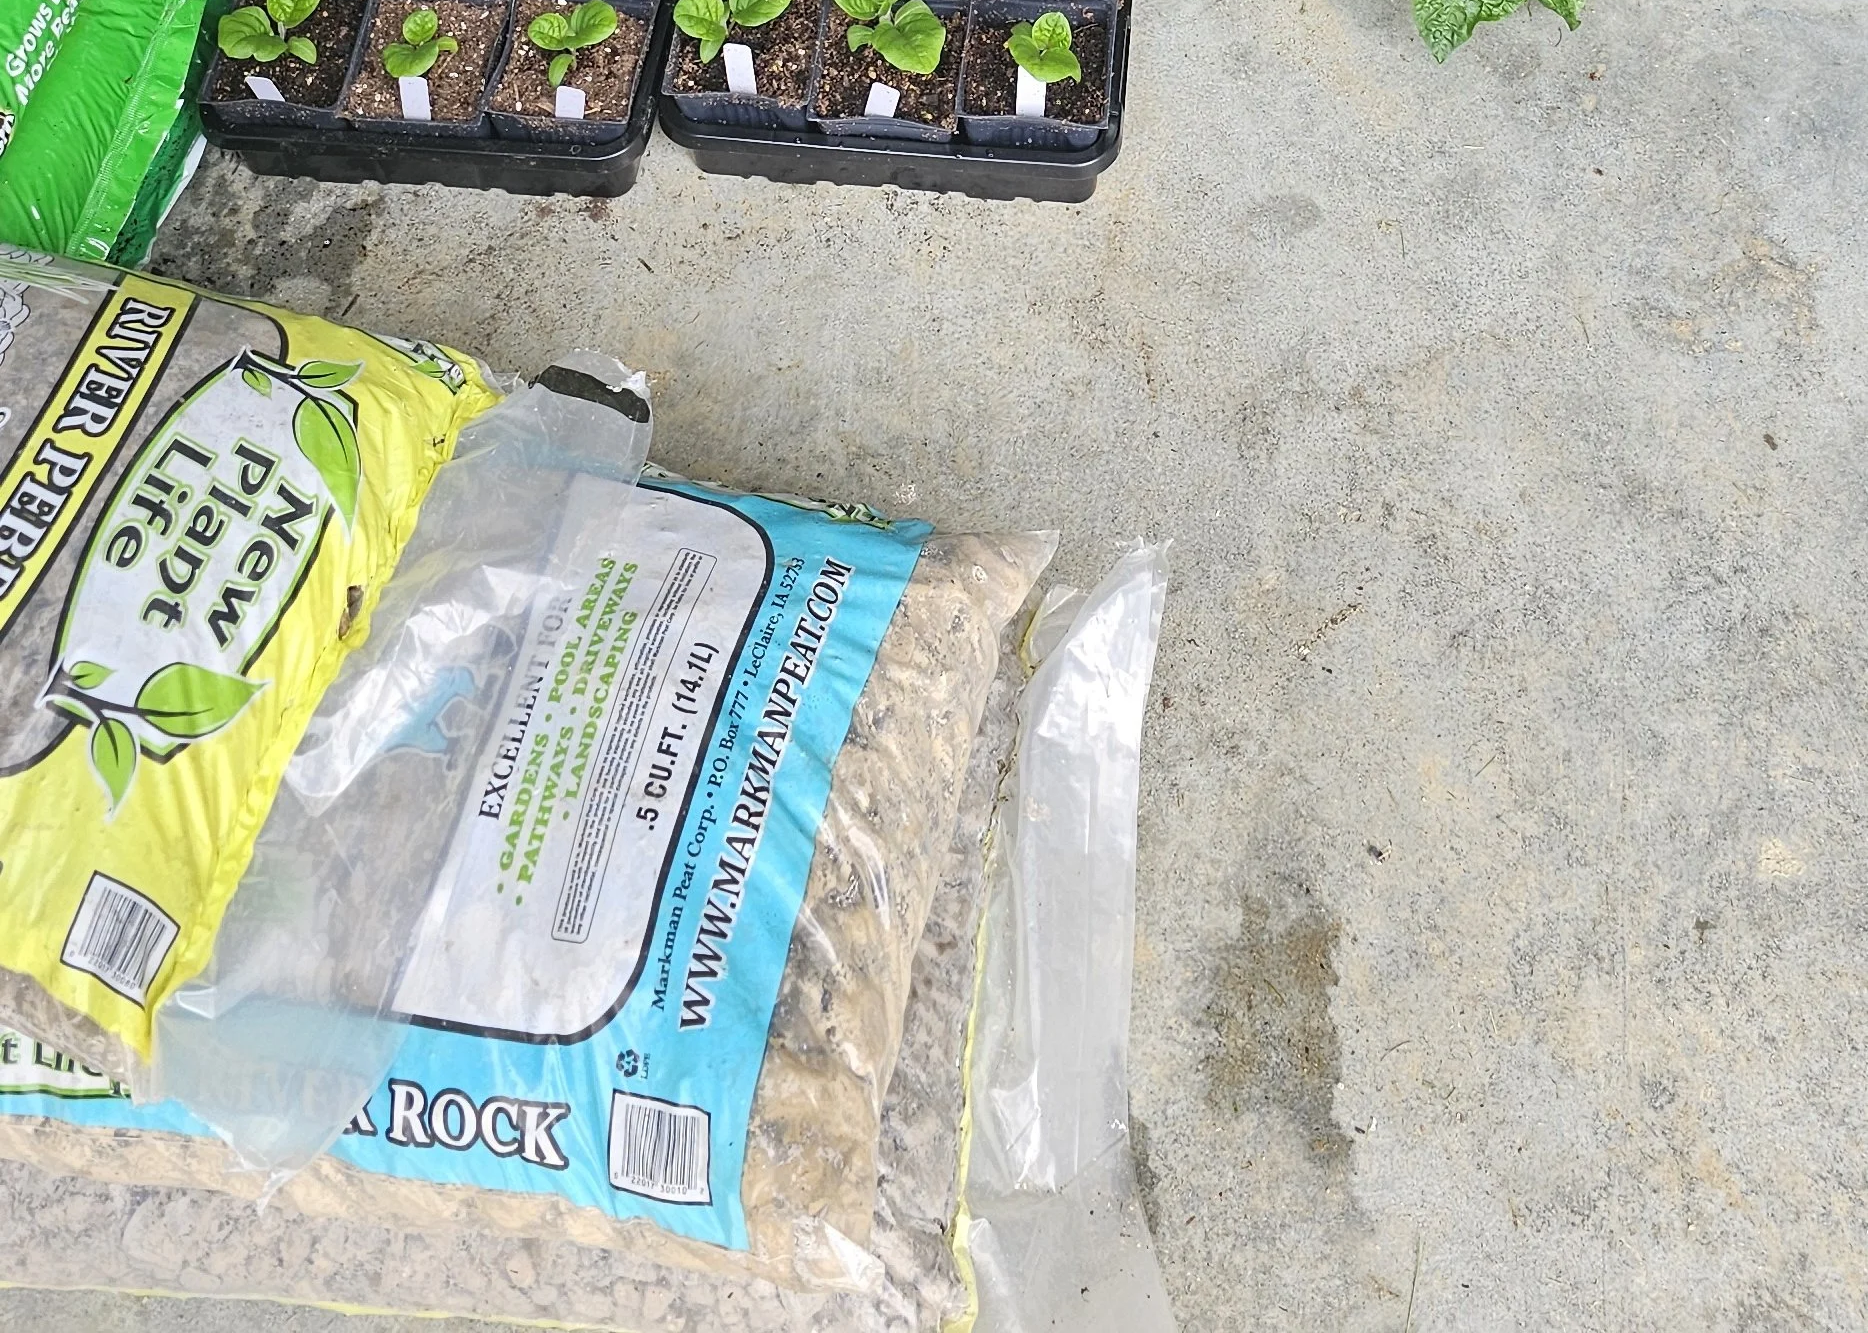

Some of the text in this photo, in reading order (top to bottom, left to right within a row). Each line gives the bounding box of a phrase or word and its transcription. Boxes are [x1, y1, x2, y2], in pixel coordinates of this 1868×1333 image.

[15, 37, 56, 106] More
[52, 297, 175, 437] RIVER
[106, 437, 213, 569] Life
[142, 441, 276, 629] Plant
[206, 480, 321, 650] New
[771, 591, 789, 610] IA
[744, 607, 784, 680] LeClaire,
[478, 596, 573, 821] EXCELLENT FOR
[500, 558, 617, 872] GARDENS POOL AREAS
[517, 562, 639, 885] PATHWAYS DRIVEWAYS
[565, 610, 638, 800] LANDSCAPING
[636, 641, 720, 833] .5 CU.FT. (14.1L)
[719, 720, 741, 751] Box
[727, 690, 751, 722] 777
[678, 557, 853, 1032] WWW.MARKMANPEAT.COM
[707, 753, 731, 788] P.O.
[685, 803, 716, 853] Corp.
[674, 855, 698, 904] Peat
[651, 906, 682, 1013] Markman
[639, 1052, 652, 1080] LDPE
[389, 1079, 570, 1170] ROCK
[631, 1175, 655, 1190] 22017
[660, 1182, 688, 1196] 30010
